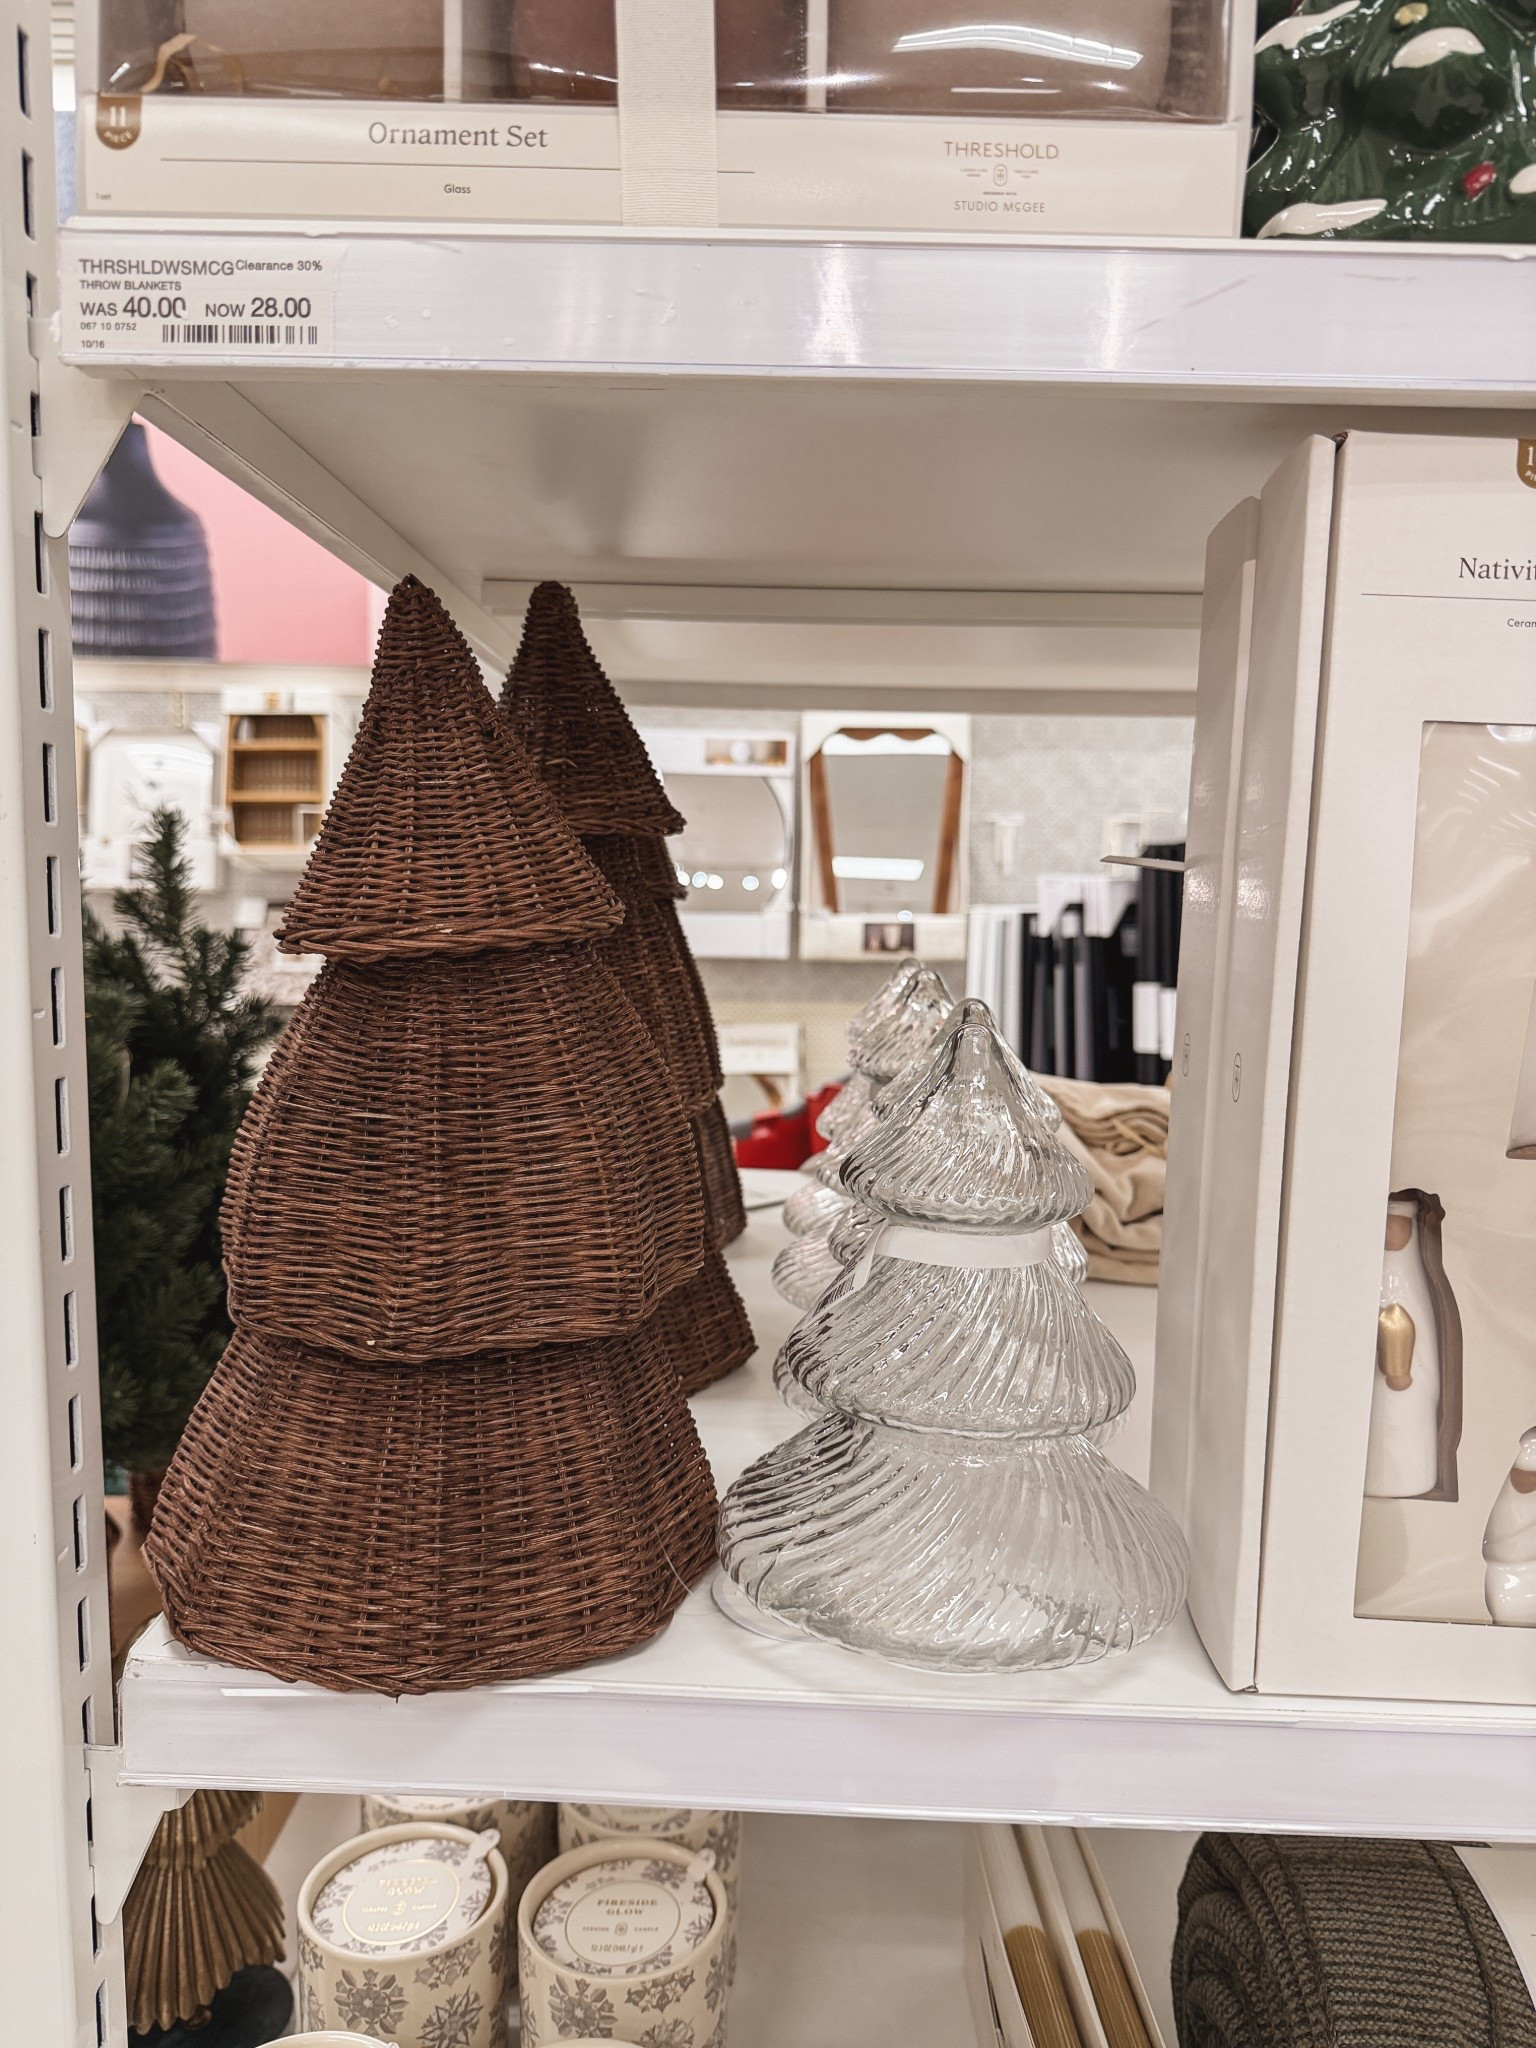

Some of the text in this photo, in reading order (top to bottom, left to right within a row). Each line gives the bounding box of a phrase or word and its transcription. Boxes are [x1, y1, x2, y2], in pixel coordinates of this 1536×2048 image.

[368, 121, 549, 148] Ornament Set
[944, 141, 1059, 160] THRESHOLD
[444, 184, 471, 194] Glass
[954, 201, 998, 212] STUDIO
[79, 258, 323, 276] THRSHLDWSMCG Clearance 30%
[80, 280, 182, 291] THROW BLANKETS
[80, 296, 312, 319] WAS 40.00 NOW 28.00
[80, 322, 137, 331] 067 10 0752
[81, 340, 105, 349] 10/16
